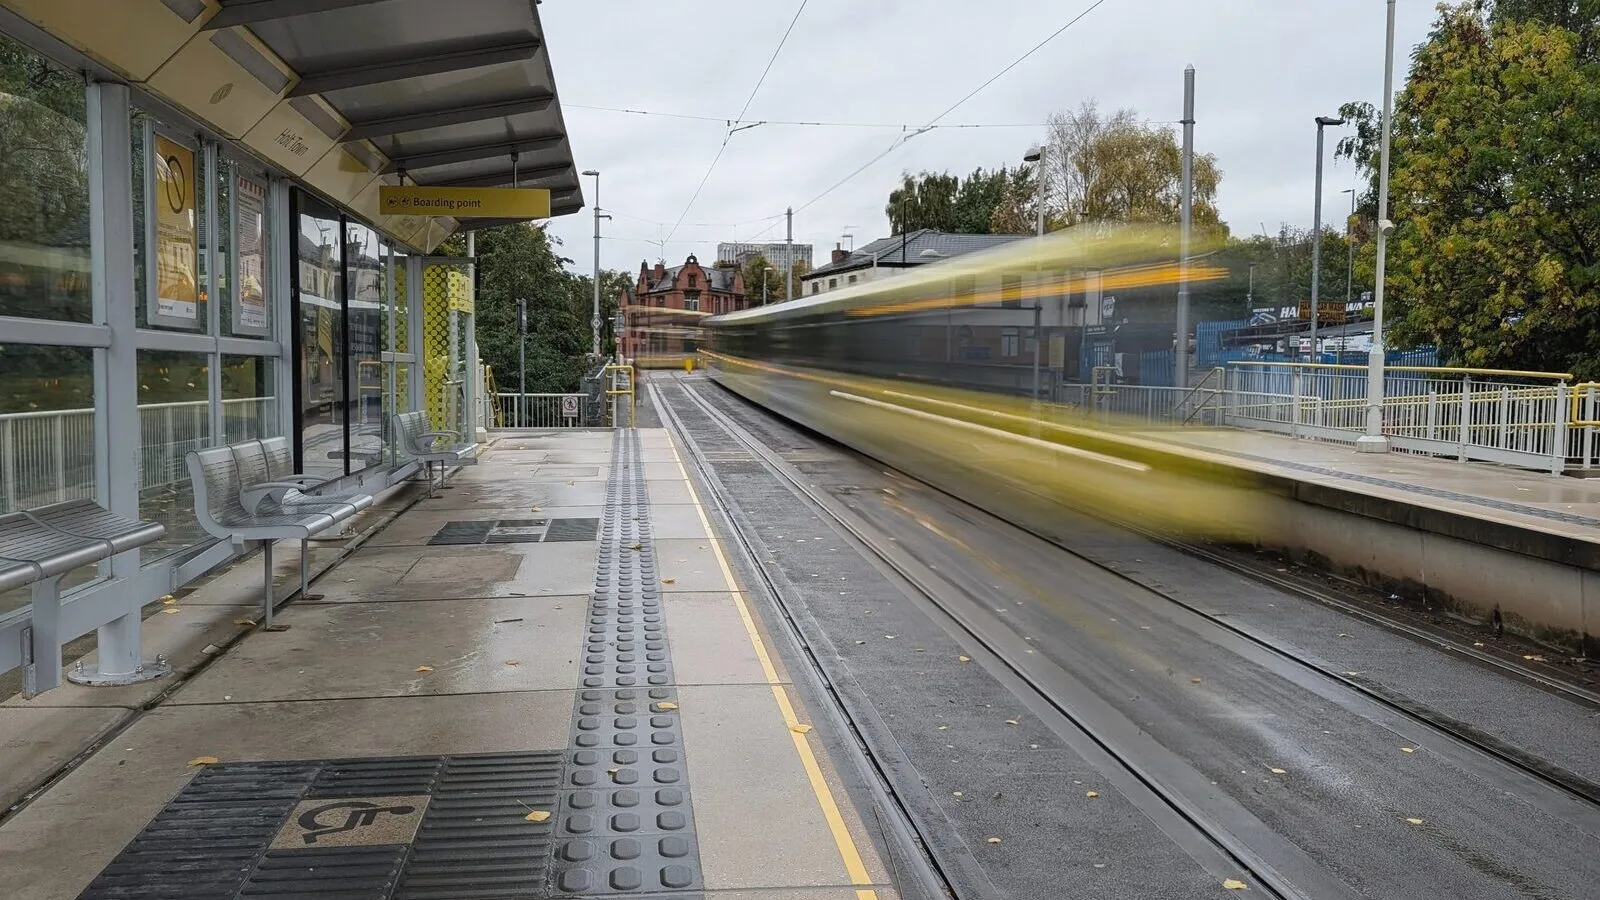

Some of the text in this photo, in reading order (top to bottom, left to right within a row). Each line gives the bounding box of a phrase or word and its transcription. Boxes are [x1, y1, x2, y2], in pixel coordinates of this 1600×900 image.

[274, 128, 309, 157] Holt Town
[413, 197, 481, 210] Boarding point
[1345, 302, 1376, 312] WAS
